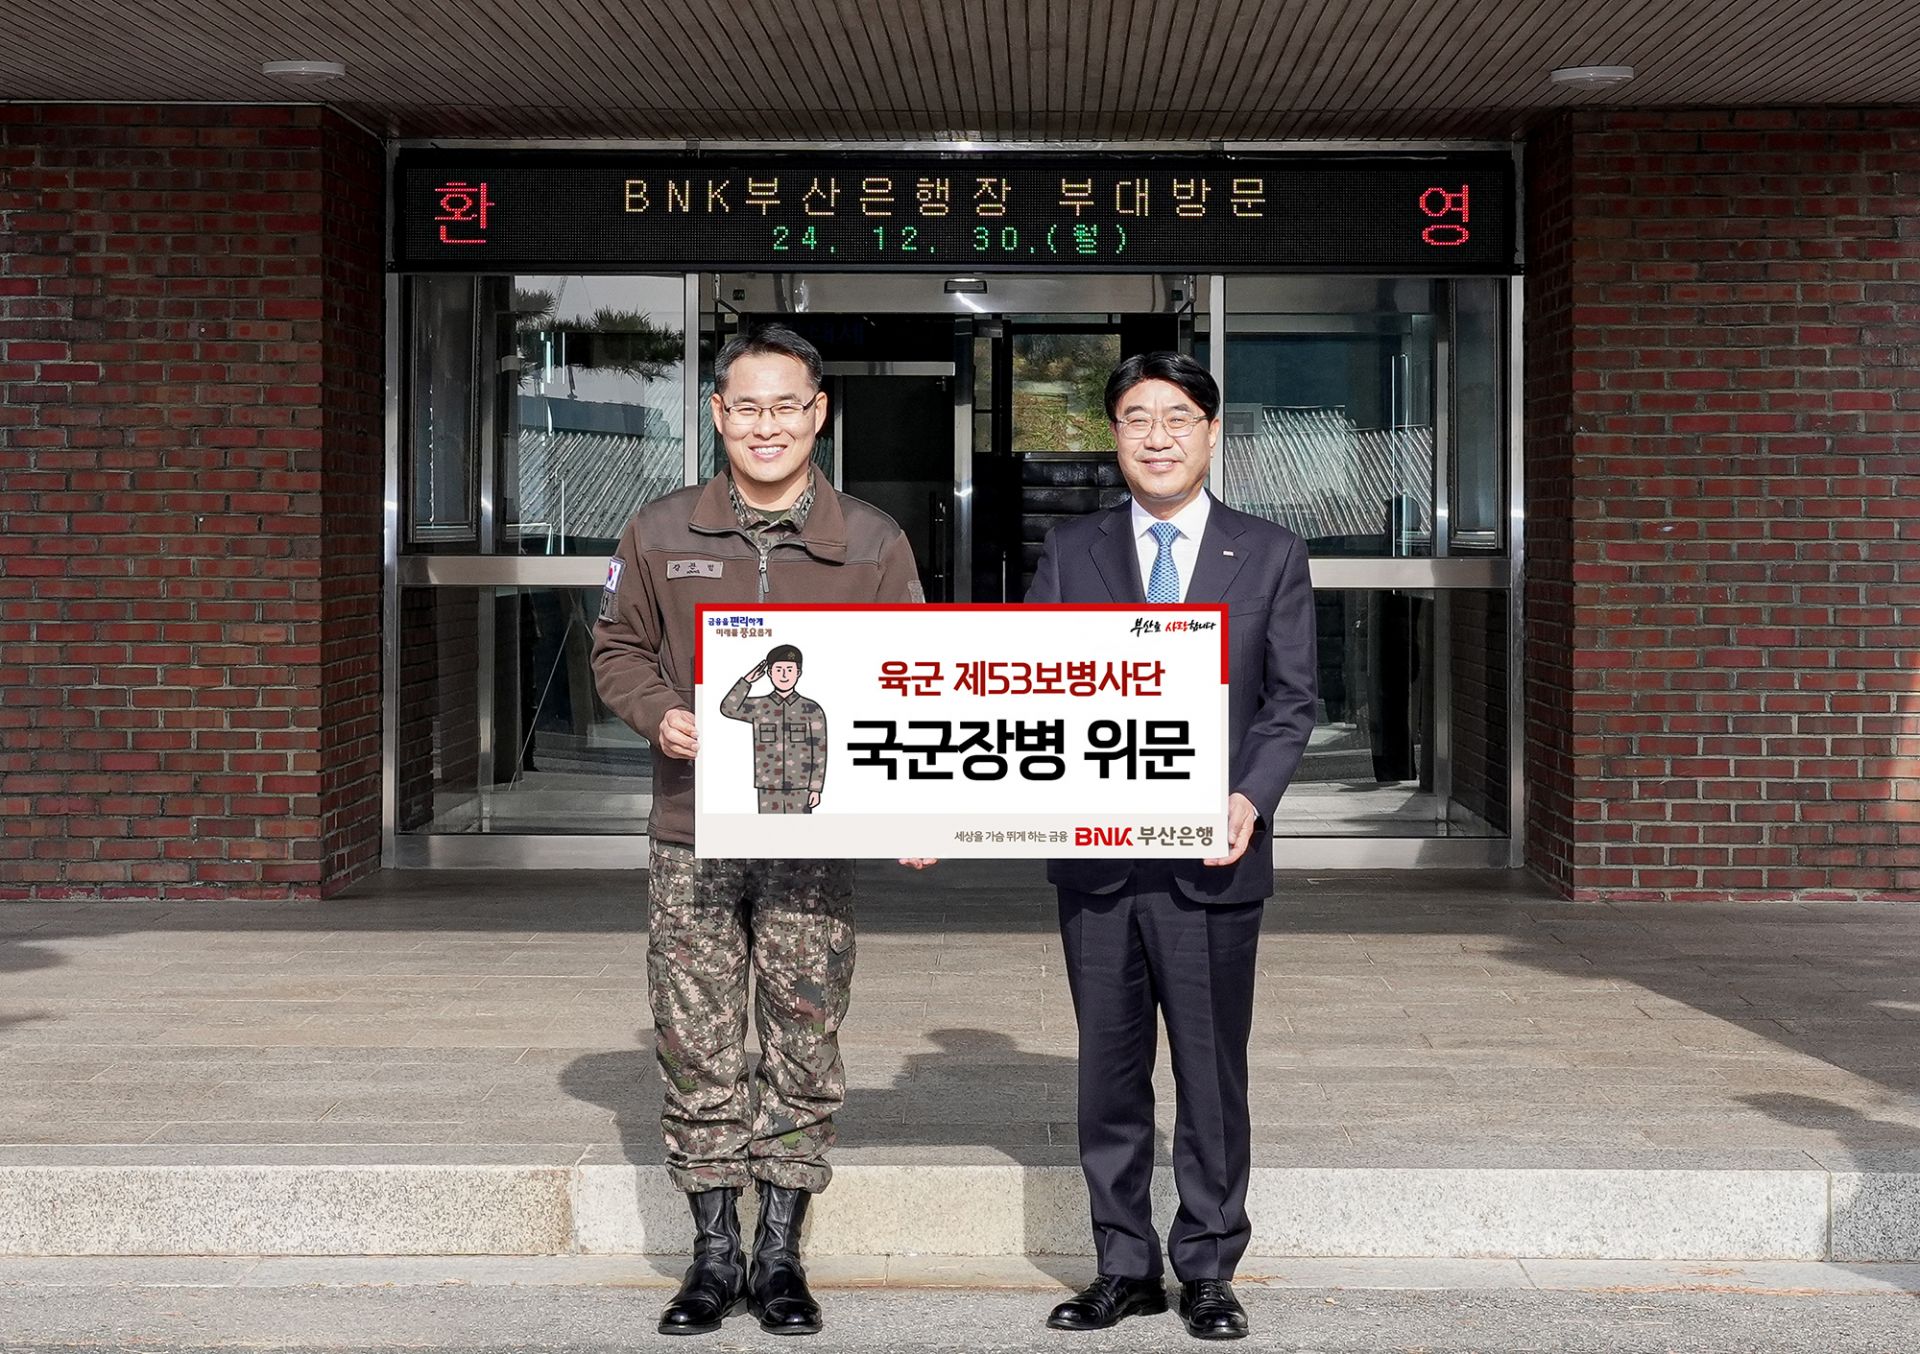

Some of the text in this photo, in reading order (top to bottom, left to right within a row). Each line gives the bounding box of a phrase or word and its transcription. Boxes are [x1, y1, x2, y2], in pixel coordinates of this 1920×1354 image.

[435, 182, 494, 243] 환
[626, 178, 1265, 216] BNK부산은행장 부대방문
[1420, 185, 1469, 245] 영
[774, 227, 834, 252] 24.
[874, 227, 934, 253] 12.
[708, 616, 763, 627] 금융을 편리하게
[716, 628, 772, 638] 미래를 풍요롭게
[1130, 618, 1216, 637] 부산을 사랑합니다
[878, 661, 1165, 697] 육군 제53보병사단
[847, 719, 1195, 781] 국군장병 위문
[955, 827, 1213, 846] 세상을 가슴 뛰게 하는 금융 BNK 부산은행
